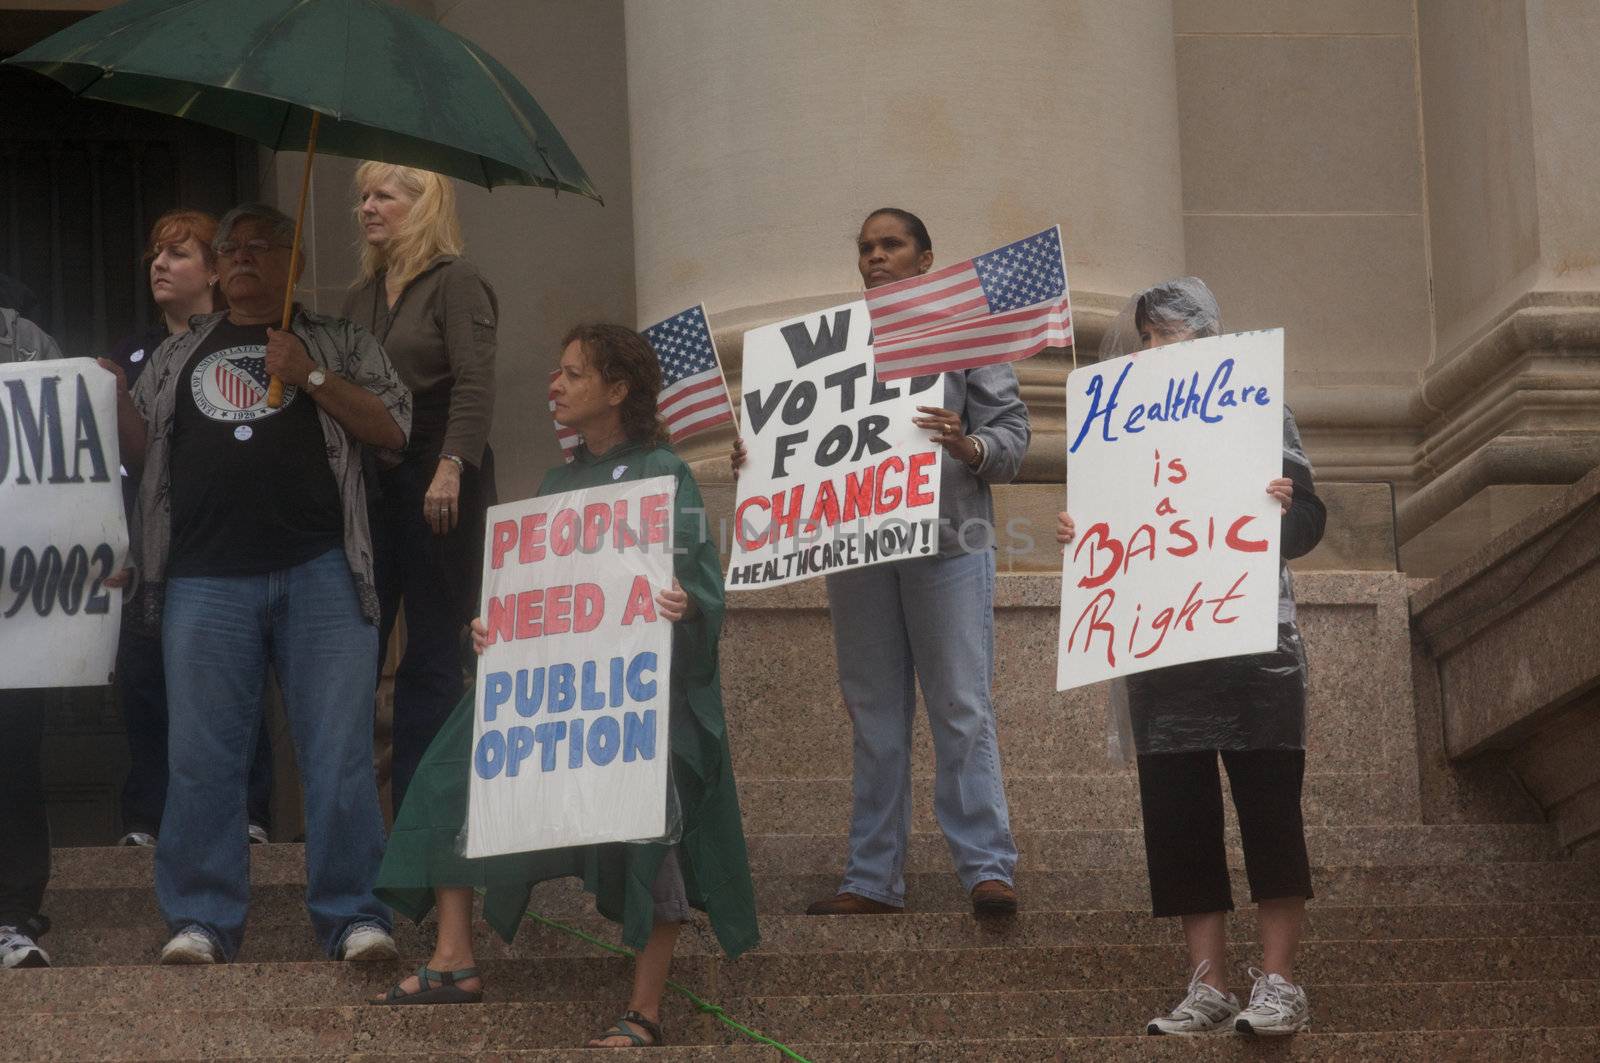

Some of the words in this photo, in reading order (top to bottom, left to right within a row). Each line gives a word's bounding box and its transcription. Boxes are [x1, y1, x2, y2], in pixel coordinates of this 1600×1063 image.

[780, 309, 875, 369] W
[1069, 358, 1271, 453] HealthCare
[771, 414, 892, 480] FOR
[1153, 449, 1189, 487] is
[491, 493, 670, 570] PEOPLE
[734, 451, 937, 551] CHANGE
[1155, 496, 1177, 516] a
[0, 542, 114, 619] 9002
[730, 533, 859, 586] HEALTHCARE
[864, 520, 931, 564] NOW!
[1073, 515, 1269, 589] BASIC
[484, 582, 606, 645] NEED
[621, 574, 657, 626] A
[1067, 571, 1249, 668] Right
[483, 651, 658, 722] PUBLIC
[474, 709, 656, 780] OPTION
